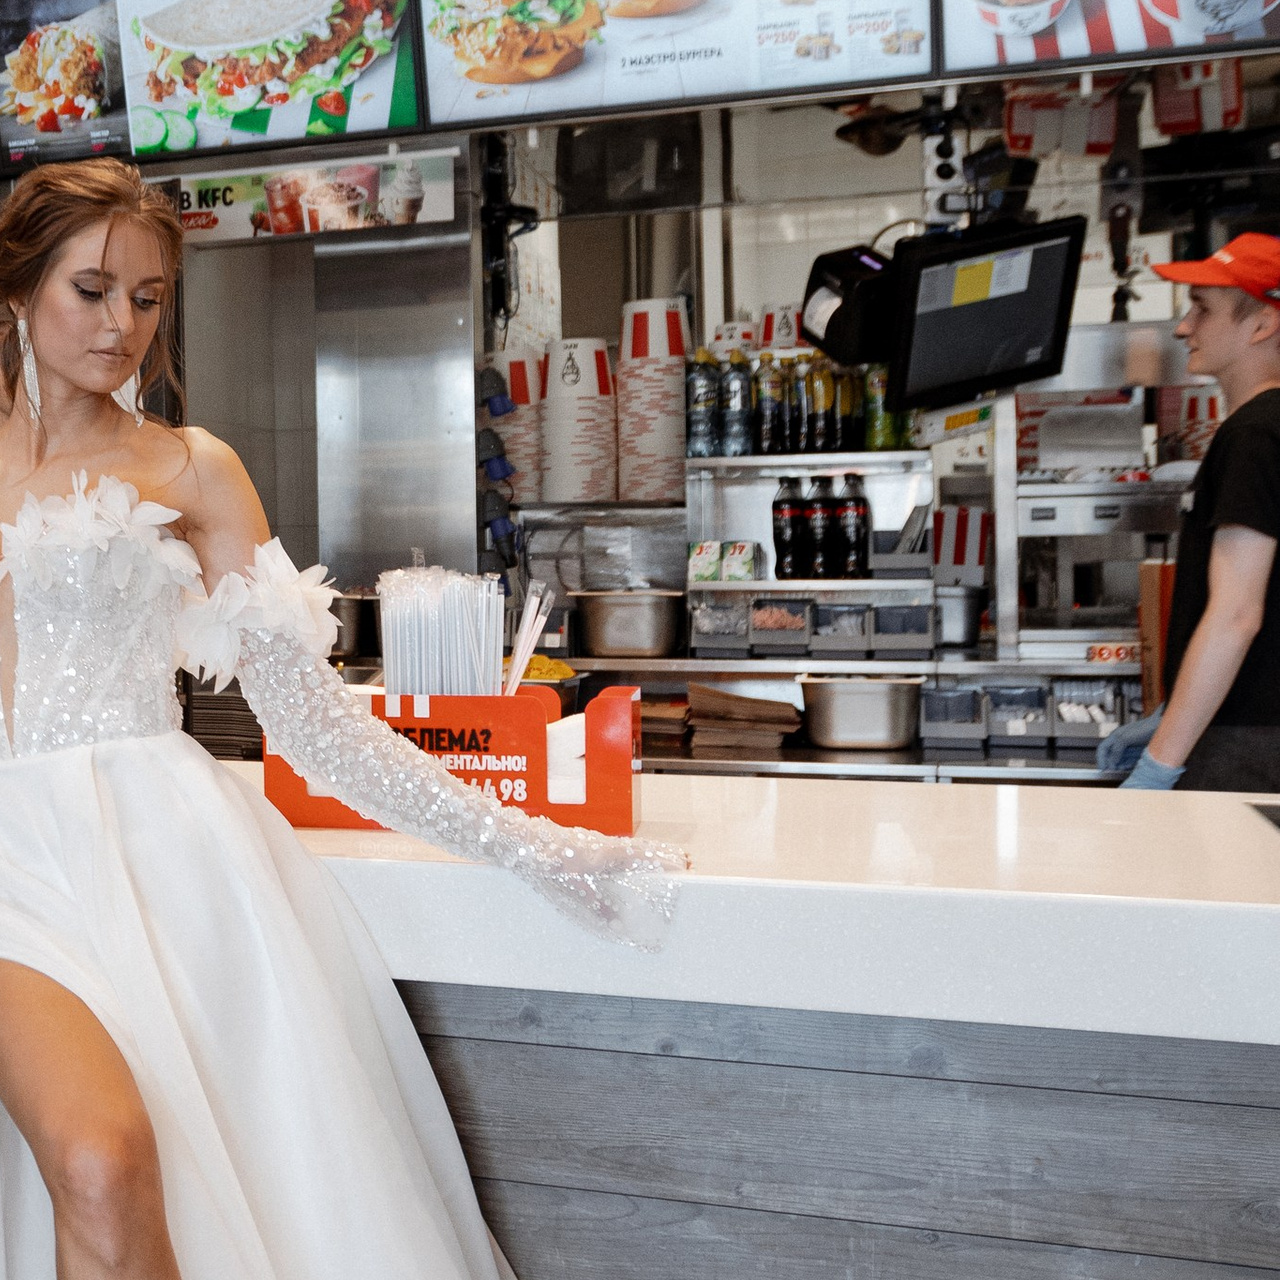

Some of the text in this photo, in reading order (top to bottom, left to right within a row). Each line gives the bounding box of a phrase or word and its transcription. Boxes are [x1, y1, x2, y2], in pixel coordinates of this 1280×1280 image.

[197, 186, 235, 210] KFC
[392, 726, 492, 753] БЛЕМА?
[500, 778, 527, 802] 98
